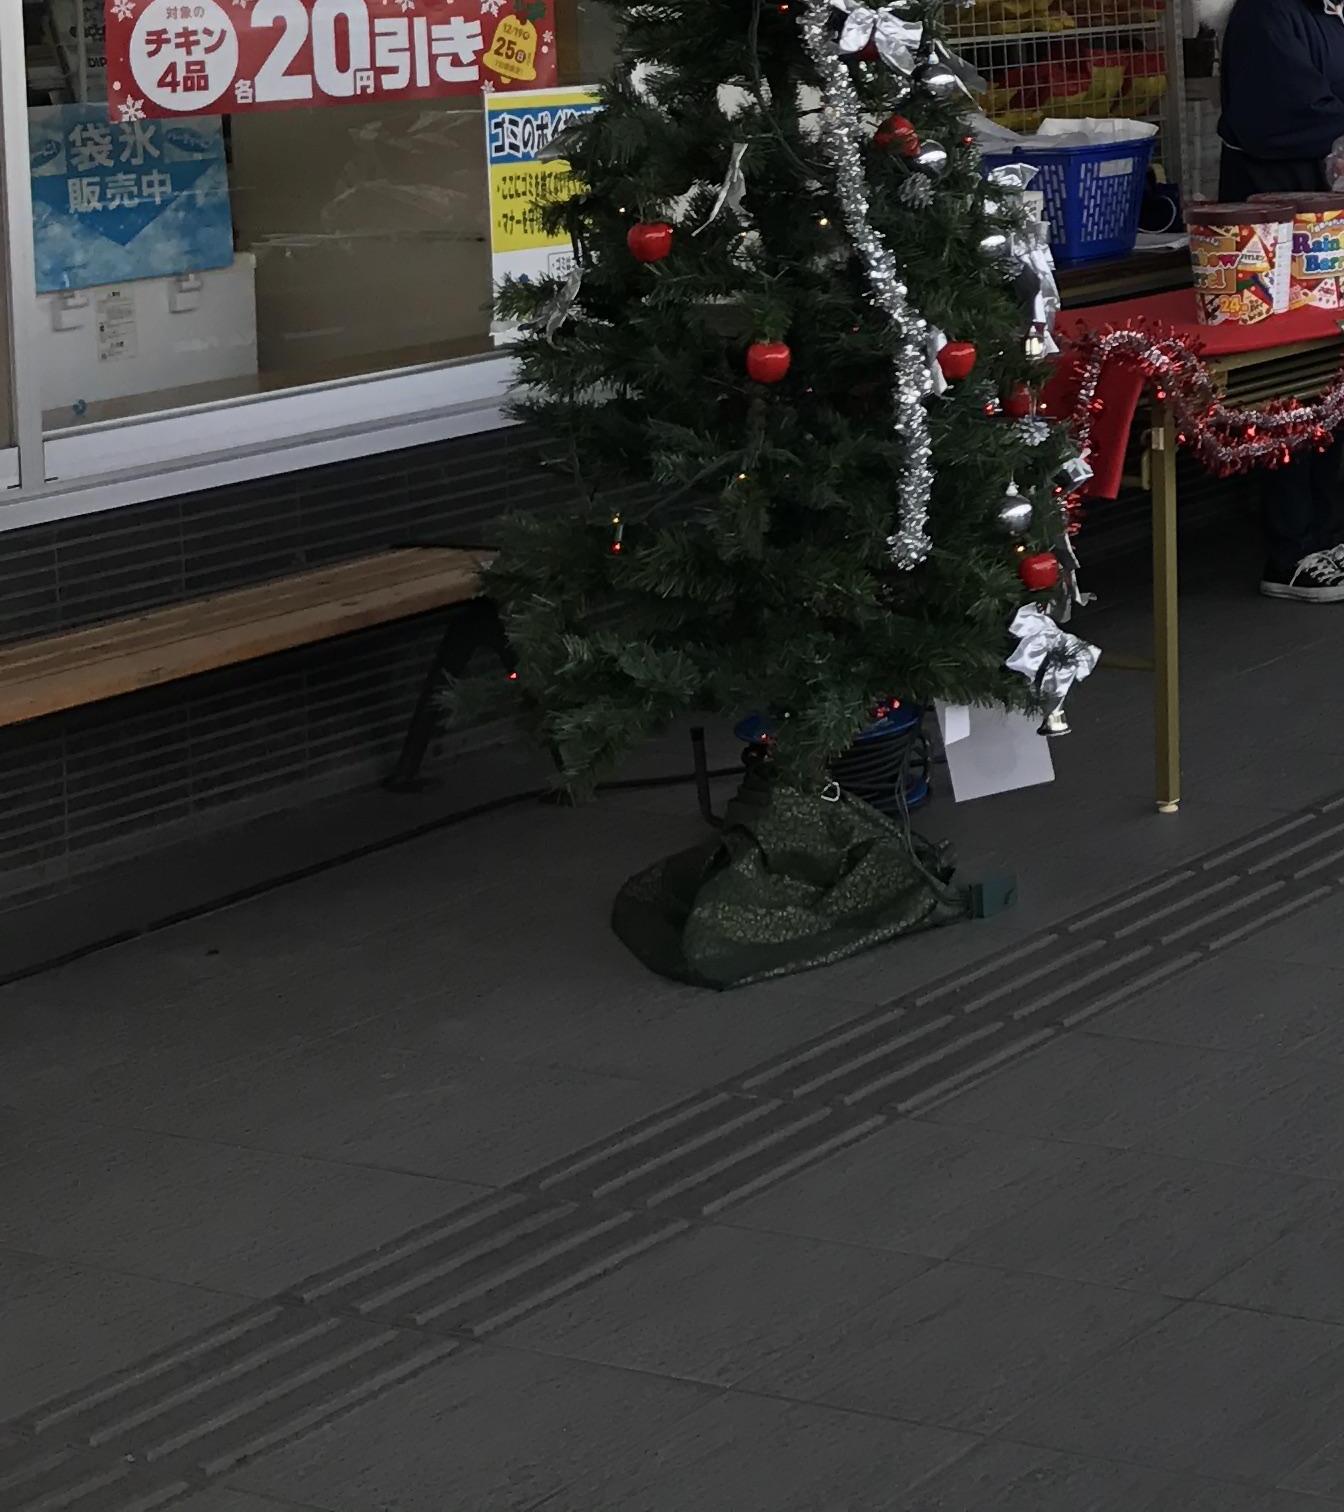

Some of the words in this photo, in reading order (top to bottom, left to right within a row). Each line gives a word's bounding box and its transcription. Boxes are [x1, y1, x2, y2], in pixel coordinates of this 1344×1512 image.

[165, 5, 205, 20] 対象の
[144, 27, 228, 58] チキン
[156, 60, 209, 94] 4品
[68, 118, 161, 171] 袋氷
[67, 168, 172, 213] 販売中
